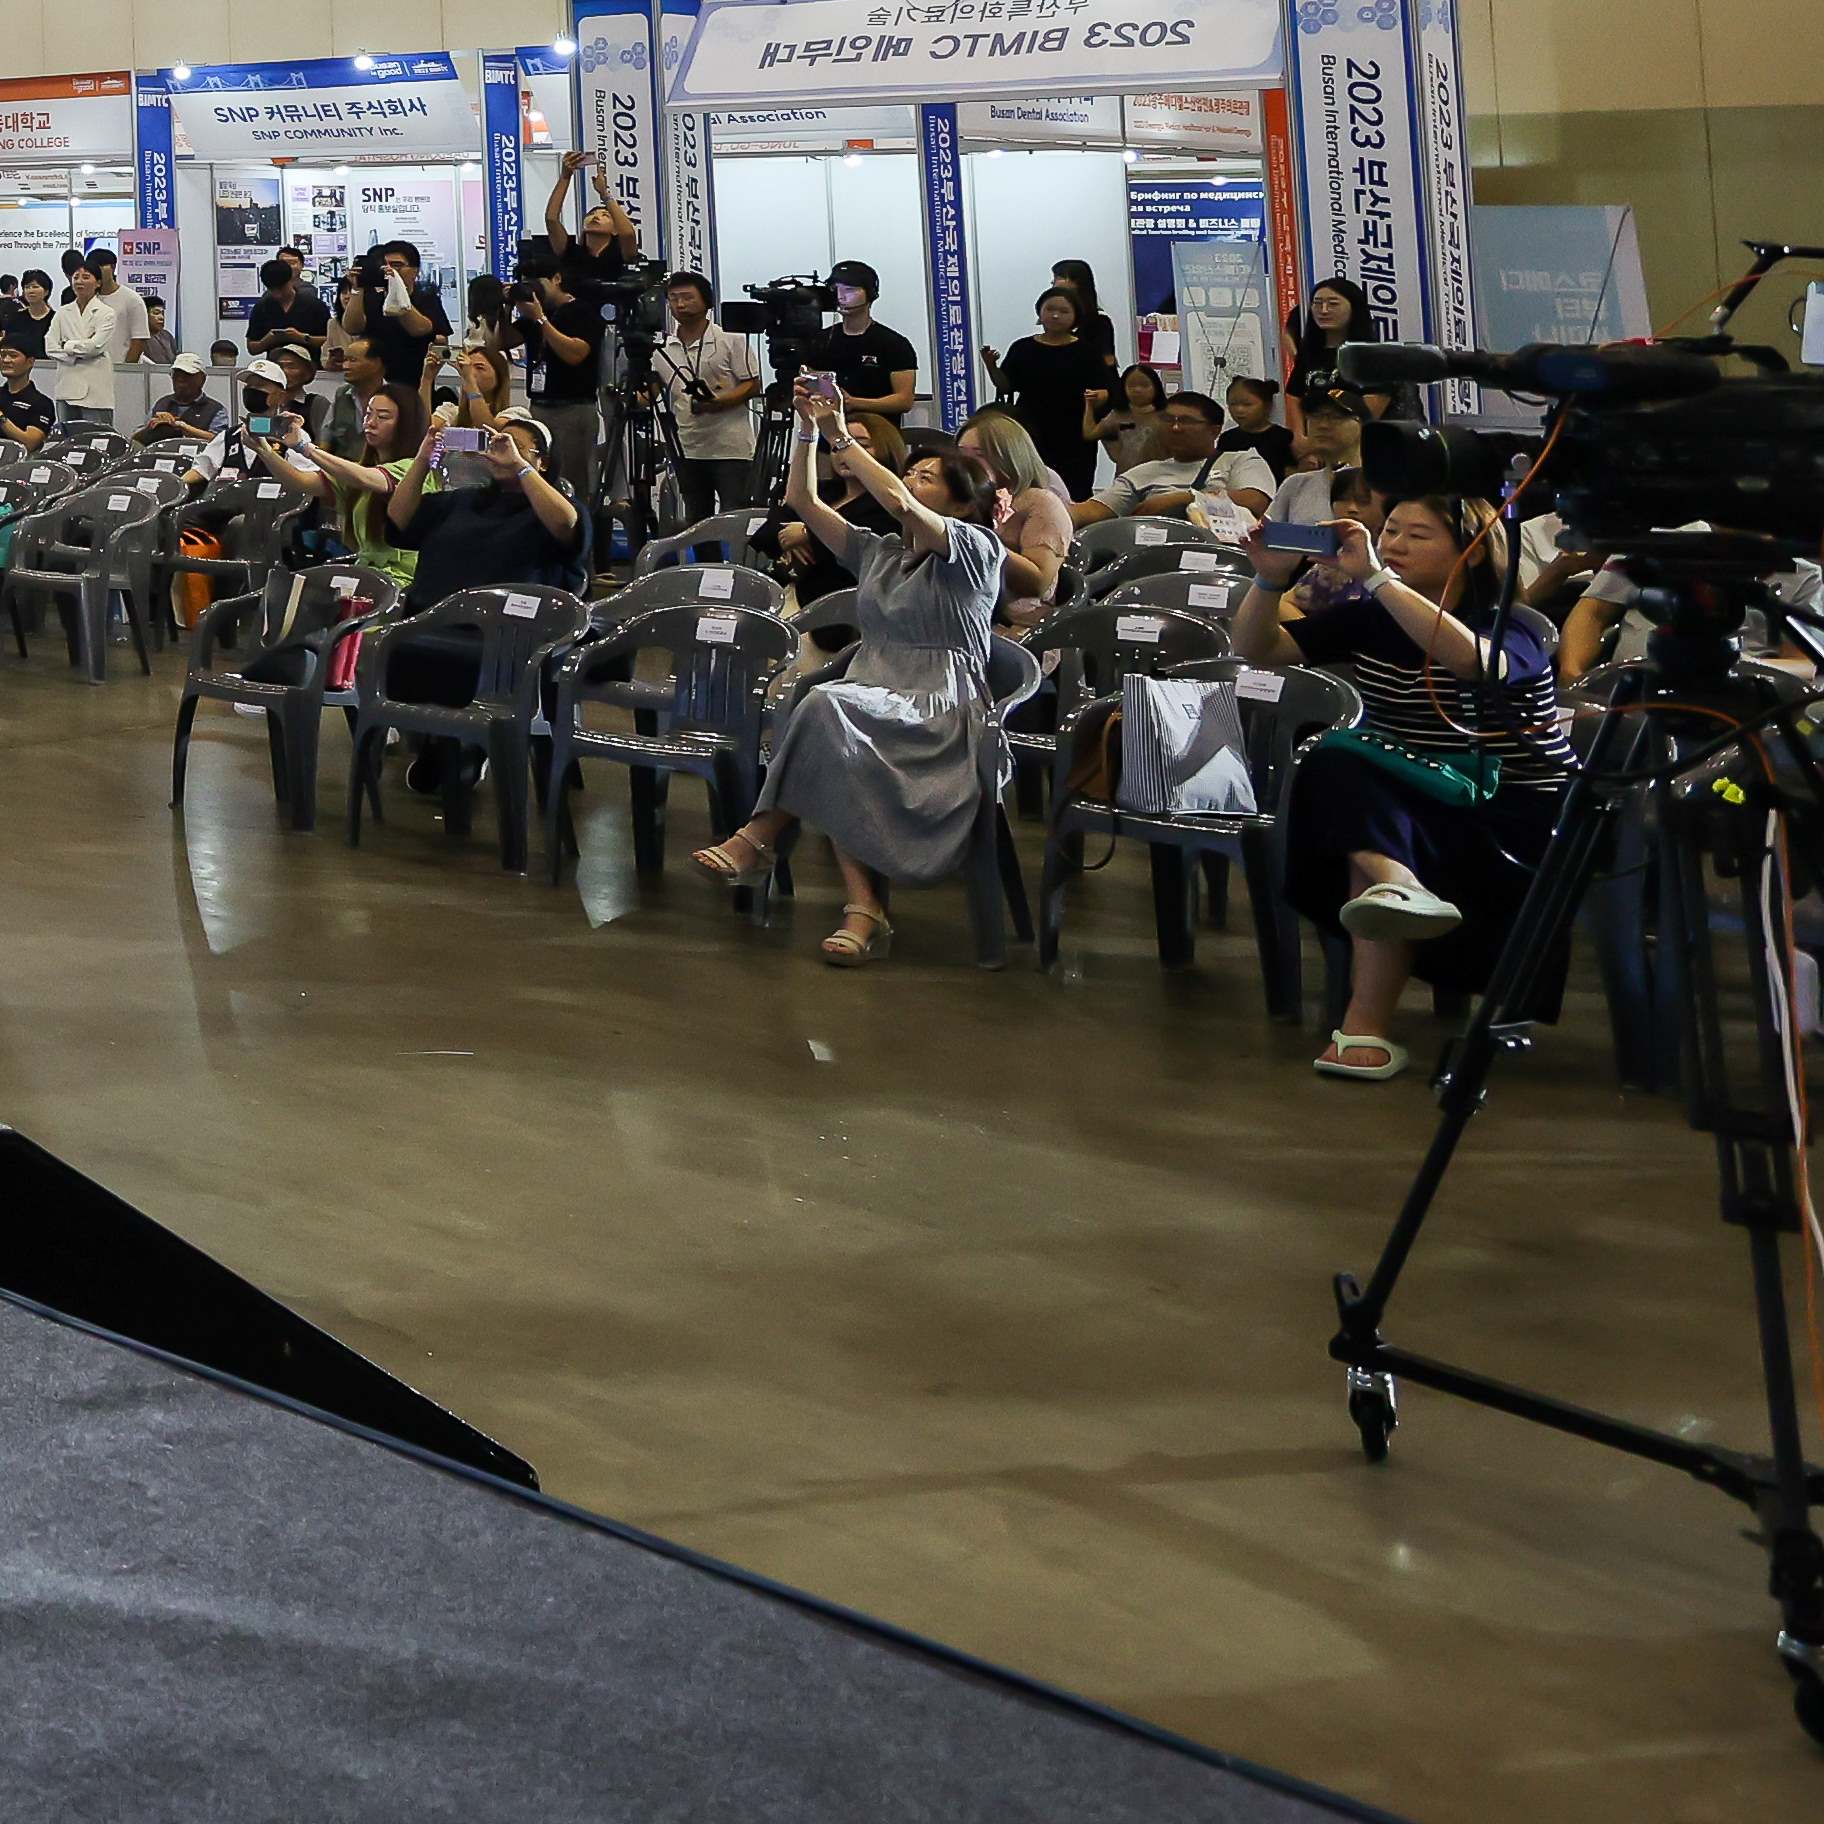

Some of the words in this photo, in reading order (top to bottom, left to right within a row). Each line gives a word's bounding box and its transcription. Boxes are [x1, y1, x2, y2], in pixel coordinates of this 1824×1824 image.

[137, 94, 169, 108] BIMTC
[485, 69, 515, 85] BIMTC
[1321, 54, 1336, 110] Busan
[1428, 52, 1436, 105] Busan
[214, 105, 259, 124] SNP
[264, 101, 341, 125] 커뮤니티
[347, 96, 428, 122] 주식회사
[595, 89, 606, 136] Busan
[727, 108, 827, 124] Association
[990, 105, 1015, 119] Busan
[1017, 106, 1042, 121] Dental
[1044, 109, 1090, 124] Association
[1346, 59, 1386, 150] 2023
[1436, 58, 1453, 152] 2023
[18, 137, 69, 150] COLLEGE
[252, 129, 282, 141] SNP
[284, 126, 375, 140] COMMUNITY
[378, 124, 403, 137] Inc.
[612, 93, 638, 169] 2023
[674, 134, 684, 217] International
[1322, 111, 1345, 217] International
[1430, 107, 1442, 213] International
[495, 163, 503, 228] International
[931, 155, 942, 238] International
[1130, 191, 1182, 202] Брифинг
[1145, 204, 1191, 213] встреча
[14, 241, 42, 250] Through
[136, 242, 160, 254] SNP
[936, 239, 946, 289] Medical
[939, 292, 948, 341] Tourism
[942, 344, 953, 421] Convention
